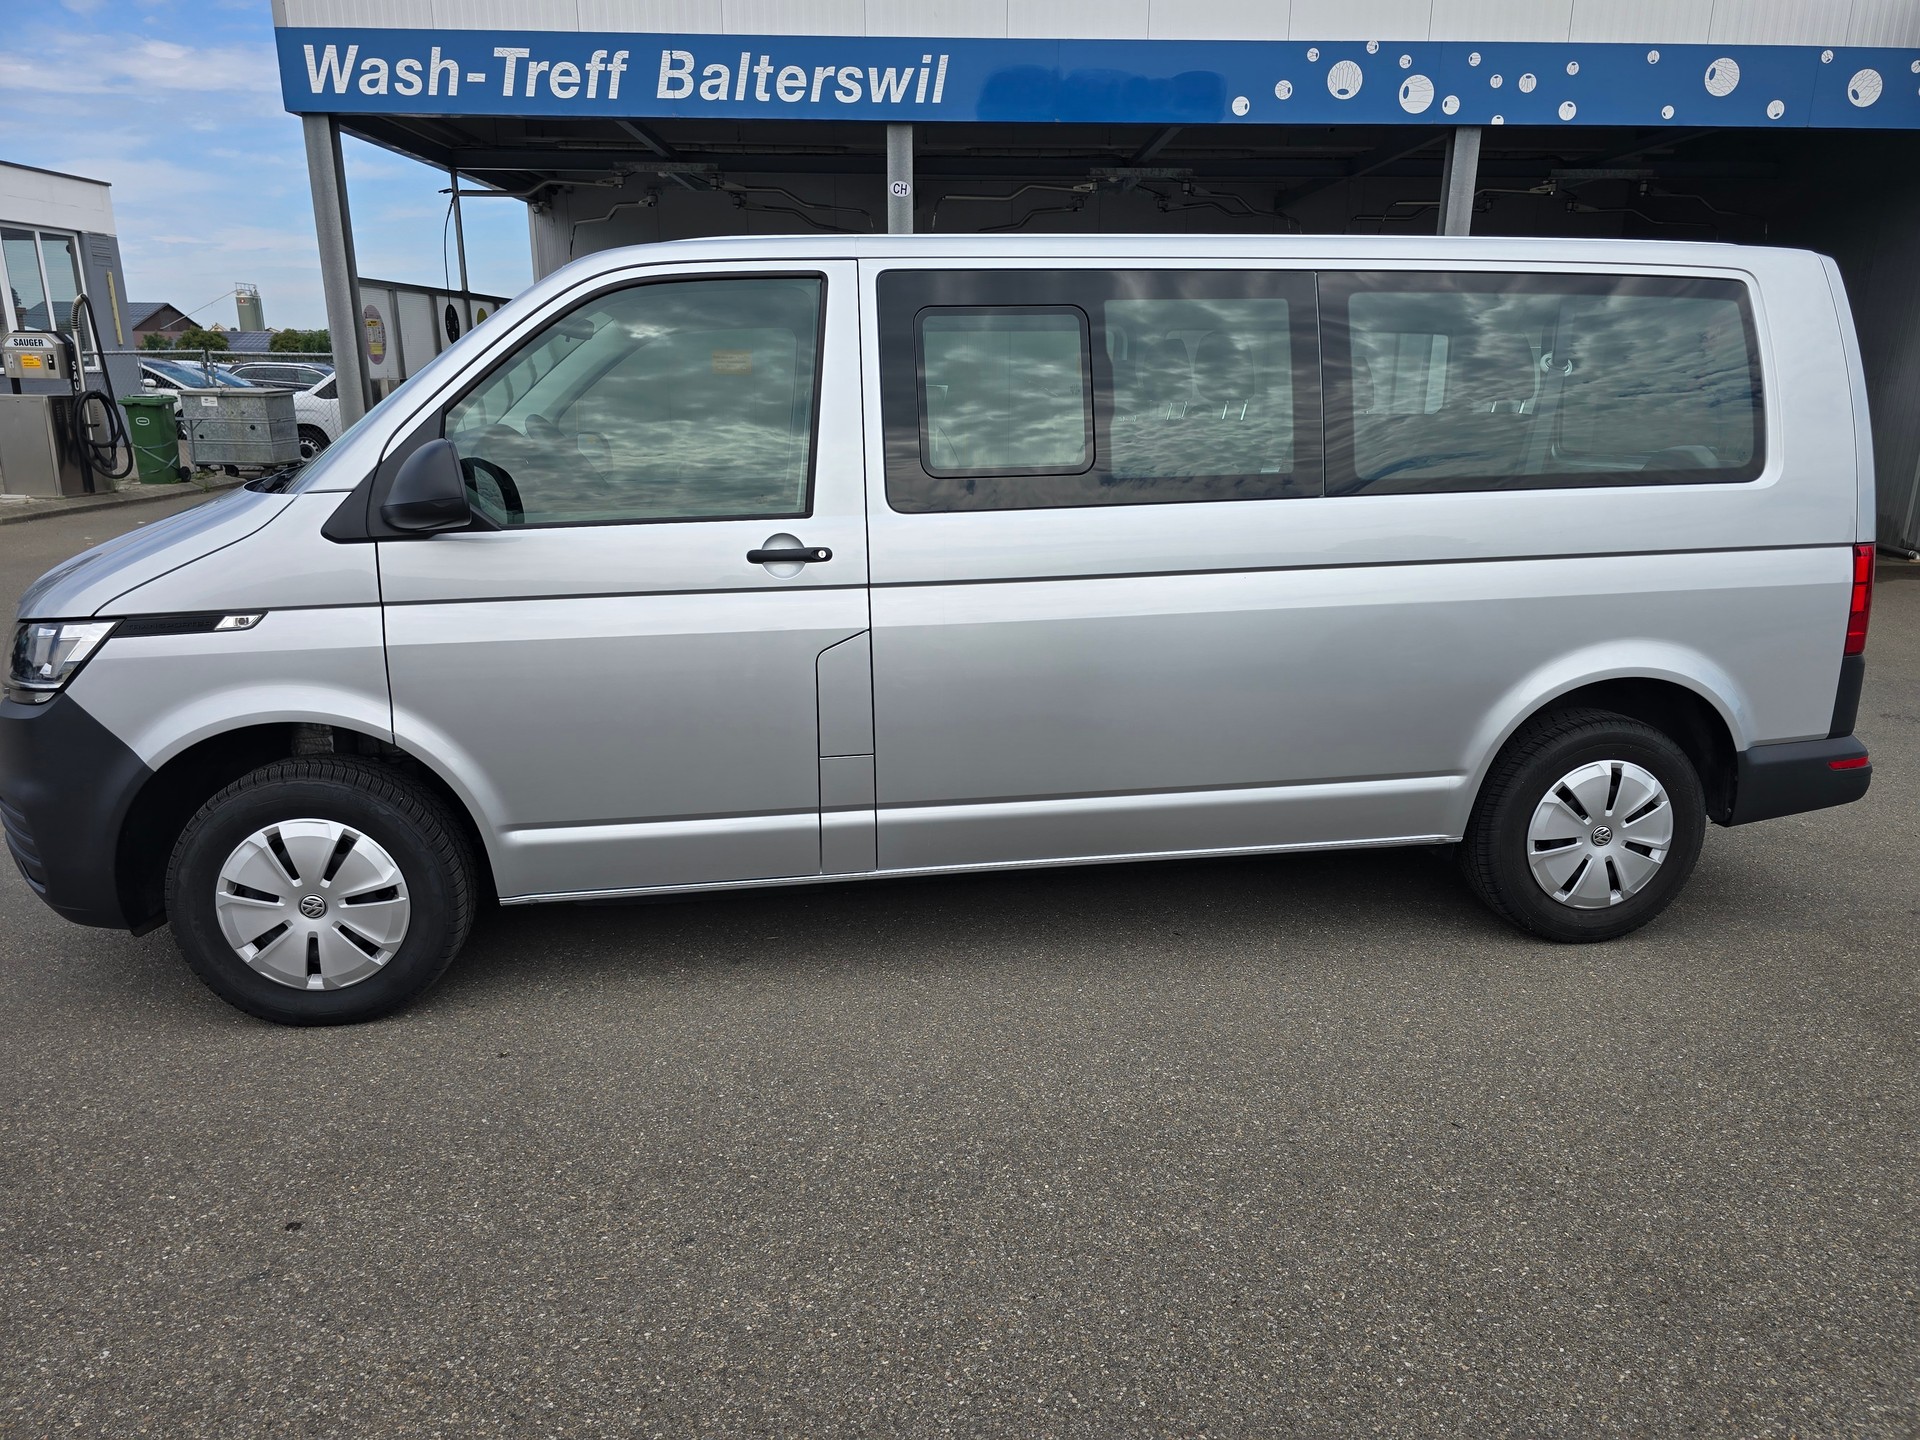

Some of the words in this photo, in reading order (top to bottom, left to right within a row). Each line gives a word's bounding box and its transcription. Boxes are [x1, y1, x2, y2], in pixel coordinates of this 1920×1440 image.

[303, 44, 630, 99] Wash-Treff
[656, 50, 949, 104] Balterswil
[893, 183, 907, 195] CH
[13, 338, 44, 347] SAUGER
